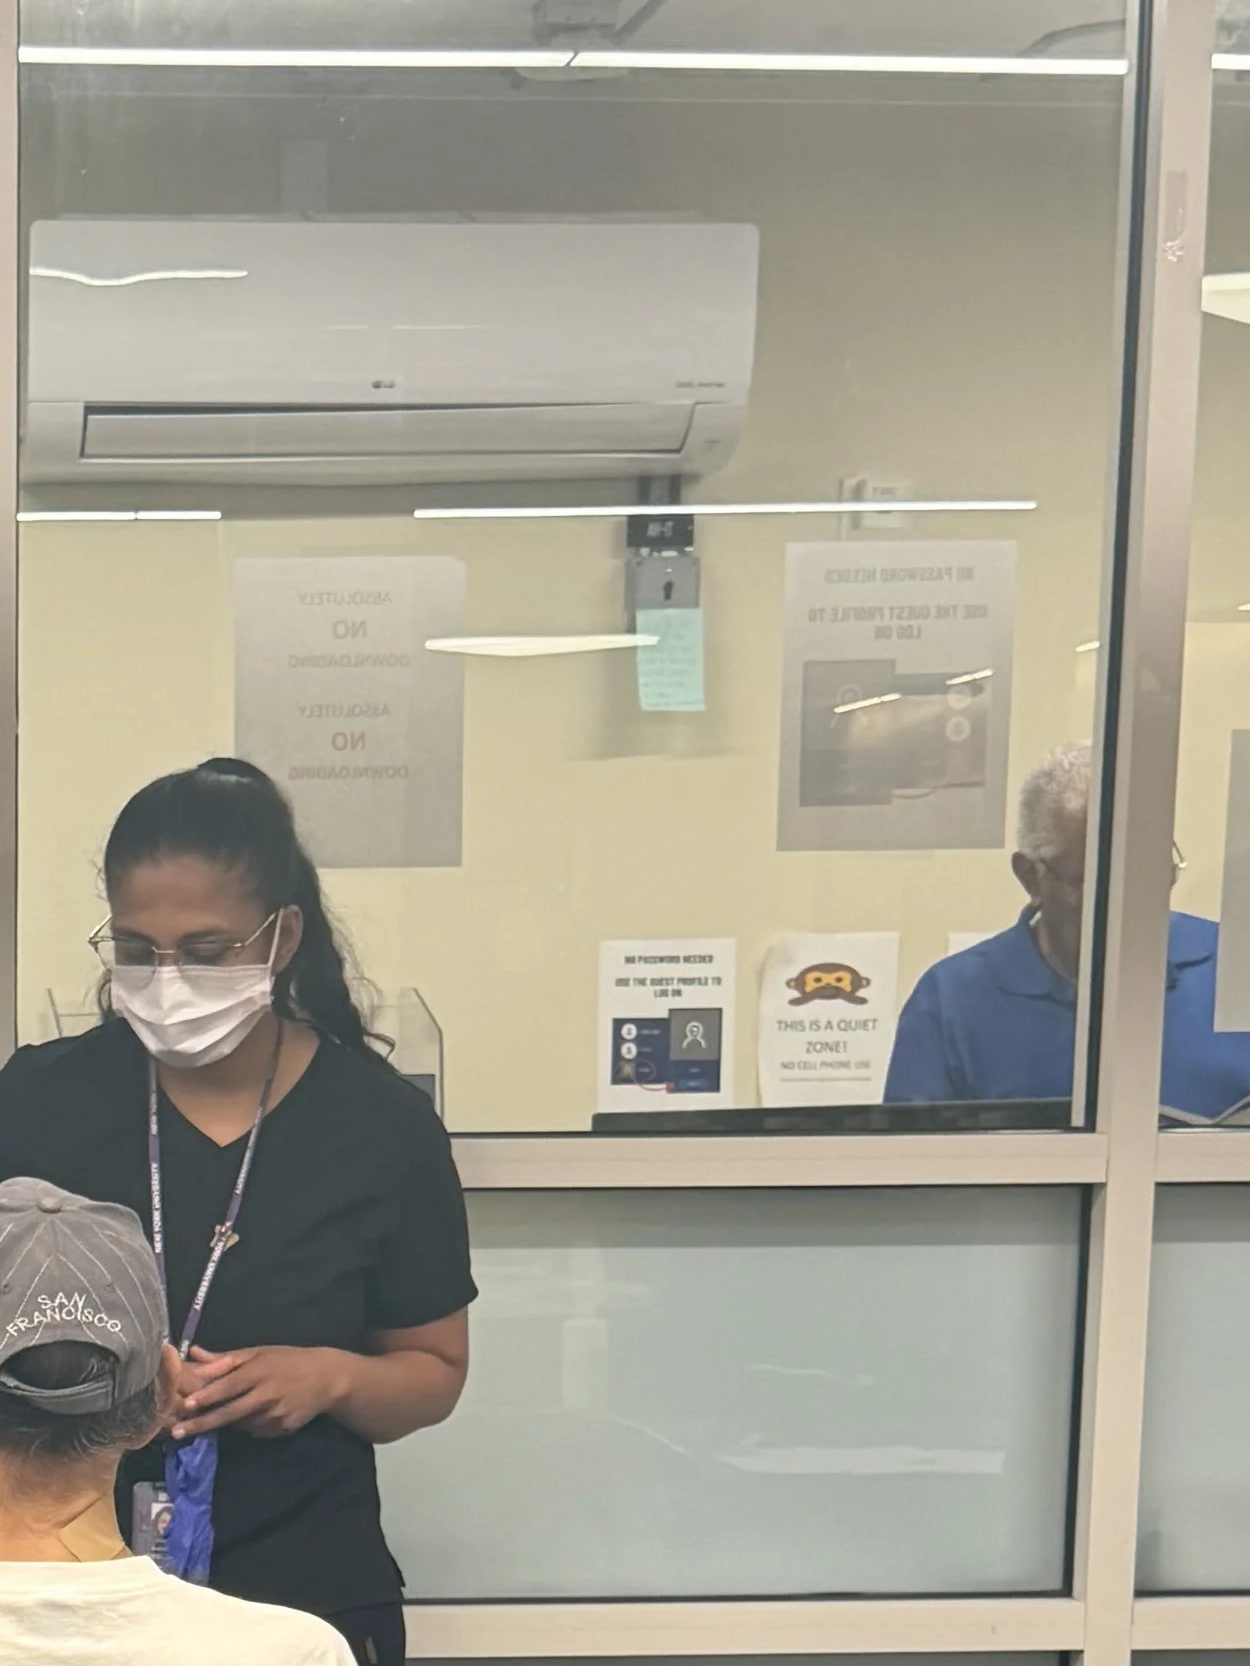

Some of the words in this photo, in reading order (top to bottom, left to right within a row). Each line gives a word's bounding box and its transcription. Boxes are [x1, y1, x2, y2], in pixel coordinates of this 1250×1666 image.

[776, 1020, 806, 1032] THIS
[810, 1020, 821, 1032] IS
[824, 1020, 834, 1031] A
[836, 1018, 878, 1032] QUIET
[806, 1040, 848, 1054] ZONE!
[37, 1292, 86, 1311] SAN
[6, 1304, 121, 1336] FRANCISCO
